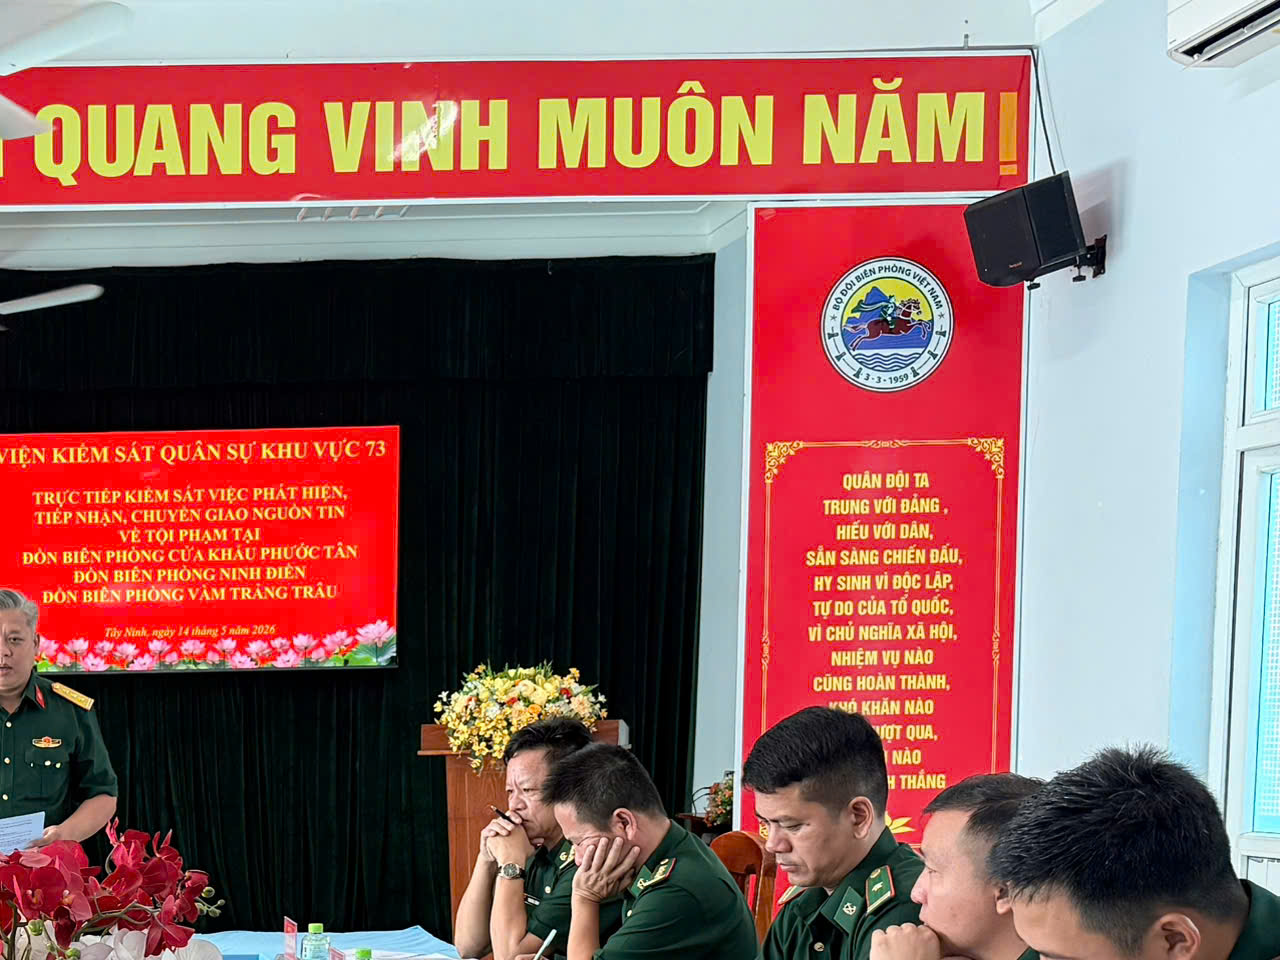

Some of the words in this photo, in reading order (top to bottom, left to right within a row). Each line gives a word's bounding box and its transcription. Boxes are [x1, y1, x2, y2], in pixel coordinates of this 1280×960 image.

[34, 101, 296, 187] QUANG
[324, 97, 508, 173] VINH
[537, 82, 775, 169] MUÔN
[832, 297, 844, 311] BỘ
[840, 279, 856, 295] ĐỘI
[856, 267, 877, 283] BIÊN
[878, 264, 912, 277] PHÒNG
[913, 271, 931, 289] VIỆT
[928, 287, 943, 310] NAM
[114, 441, 155, 462] SÁT
[160, 440, 220, 465] QUÂN
[227, 441, 256, 464] SỰ
[261, 442, 308, 459] KHU
[314, 438, 360, 462] VỰC
[366, 440, 385, 456] 73
[843, 471, 881, 490] QUÂN
[886, 470, 909, 491] ĐỘI
[913, 473, 929, 488] TA
[32, 490, 80, 508] TRỰC
[173, 484, 205, 502] SÁT
[209, 486, 248, 504] VIỆC
[253, 484, 298, 500] PHÁT
[302, 484, 347, 502] HIỆN,
[823, 499, 869, 515] TRUNG
[874, 496, 896, 514] VỚI
[205, 508, 248, 521] GIAO
[317, 505, 345, 519] TIN
[145, 528, 174, 546] TỘI
[179, 528, 227, 544] PHẠM
[232, 528, 261, 544] TẠI
[836, 520, 869, 540] HIẾU
[873, 521, 895, 539] VỚI
[900, 521, 934, 540] DÂN,
[63, 547, 101, 564] BIÊN
[106, 547, 164, 563] PHÒNG
[261, 542, 320, 560] PHƯỚC
[323, 542, 358, 558] TÂN
[840, 547, 879, 565] SÀNG
[883, 544, 926, 564] CHIẾN
[930, 544, 962, 565] ĐẤU,
[114, 566, 152, 583] BIÊN
[157, 566, 215, 581] PHÒNG
[220, 567, 261, 580] NINH
[814, 576, 832, 591] HY
[837, 575, 871, 590] SINH
[875, 572, 888, 590] VÌ
[893, 572, 920, 592] ĐỘC
[925, 571, 953, 592] LẬP,
[82, 586, 120, 602] BIÊN
[125, 586, 184, 602] PHÒNG
[291, 581, 336, 598] TRÂU
[813, 600, 832, 619] TỰ
[835, 601, 853, 616] DO
[858, 595, 886, 615] CỦA
[911, 594, 954, 616] QUỐC,
[152, 627, 175, 639] ngày
[178, 626, 189, 636] 14
[191, 625, 219, 638] tháng
[221, 625, 227, 636] 5
[252, 624, 276, 635] 2026
[808, 623, 821, 641] VÌ
[826, 621, 854, 641] CHỦ
[859, 622, 902, 640] NGHĨA
[906, 622, 925, 640] XÃ
[929, 621, 958, 642] HỘI,
[831, 648, 877, 669] NHIỆM
[882, 650, 900, 668] VỤ
[904, 647, 934, 664] NÀO
[813, 674, 852, 691] CŨNG
[856, 672, 896, 690] HOÀN
[899, 672, 950, 690] THÀNH,
[861, 698, 900, 715] KHĂN
[904, 697, 934, 714] NÀO
[906, 725, 938, 741] QUA,
[892, 747, 921, 765] NÀO
